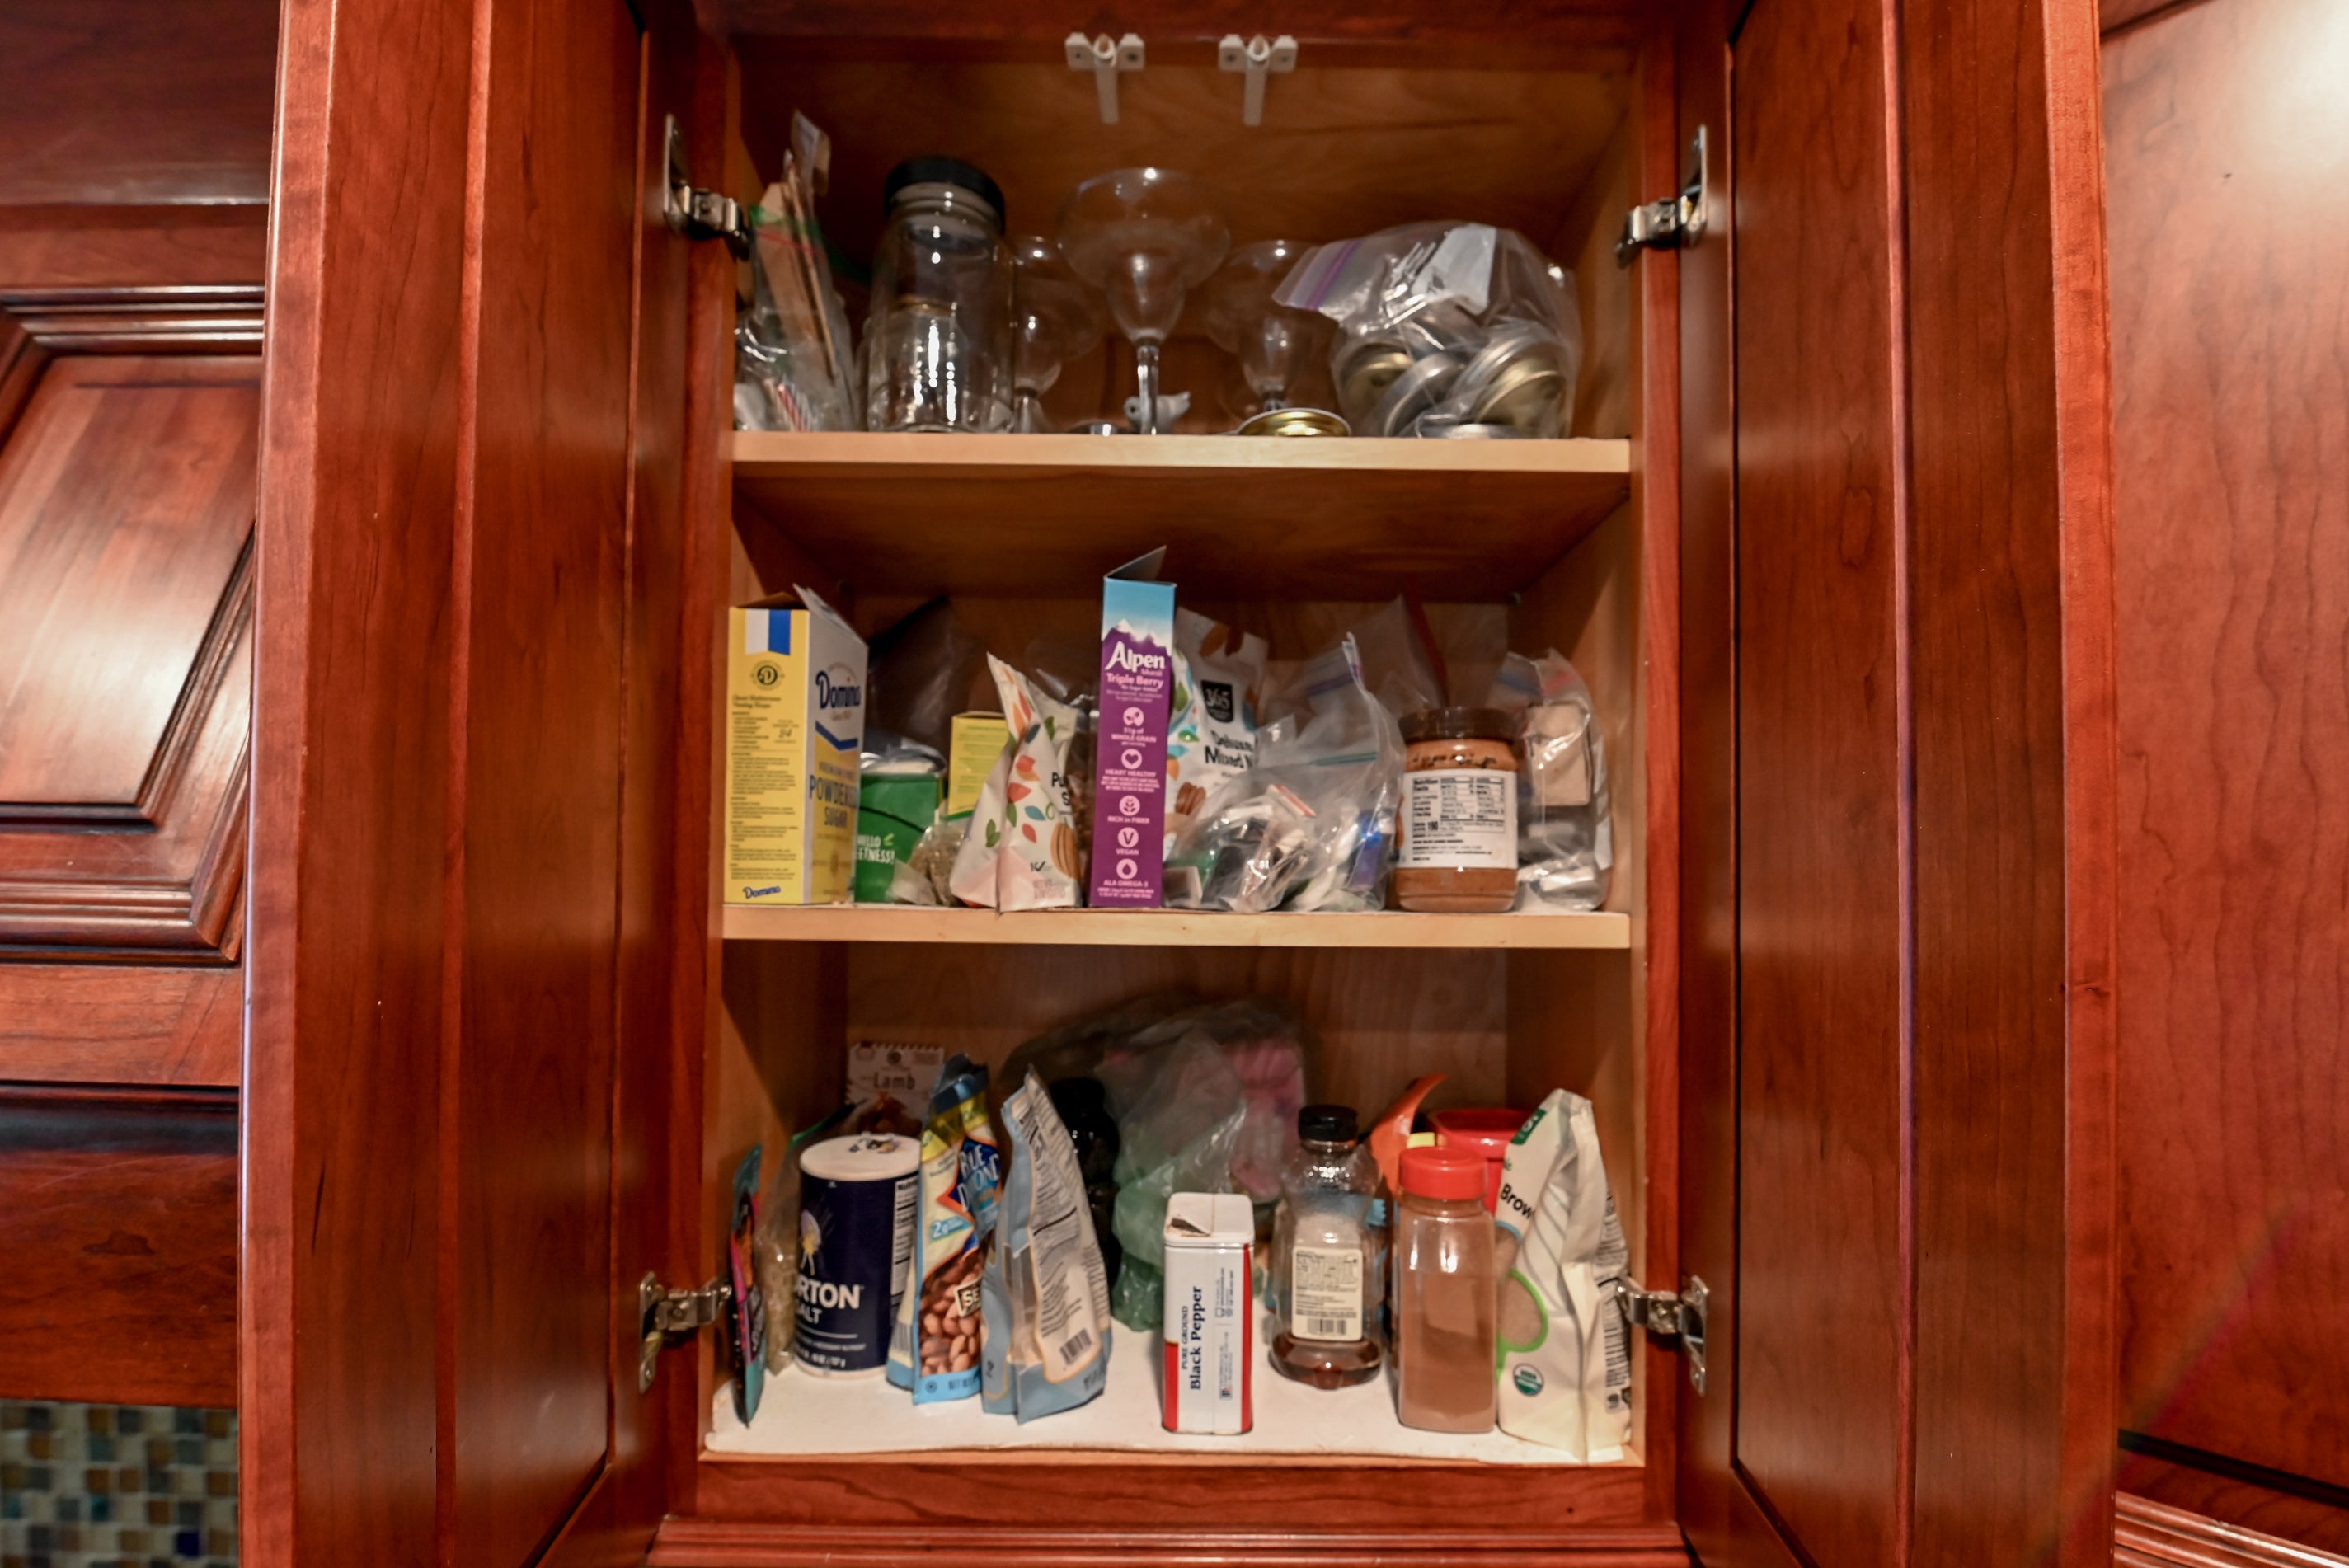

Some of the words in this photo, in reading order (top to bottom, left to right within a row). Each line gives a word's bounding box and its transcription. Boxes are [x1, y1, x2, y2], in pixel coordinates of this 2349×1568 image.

[1105, 641, 1165, 673] Alpen
[815, 670, 861, 709] Domino
[1106, 672, 1135, 686] Triple
[1136, 675, 1163, 690] Berry
[1205, 688, 1230, 709] 365
[743, 885, 782, 899] Domino
[874, 1071, 916, 1090] Lamb
[796, 1274, 861, 1309] RTON
[1191, 1287, 1205, 1340] Pepper
[1190, 1345, 1201, 1391] Black
